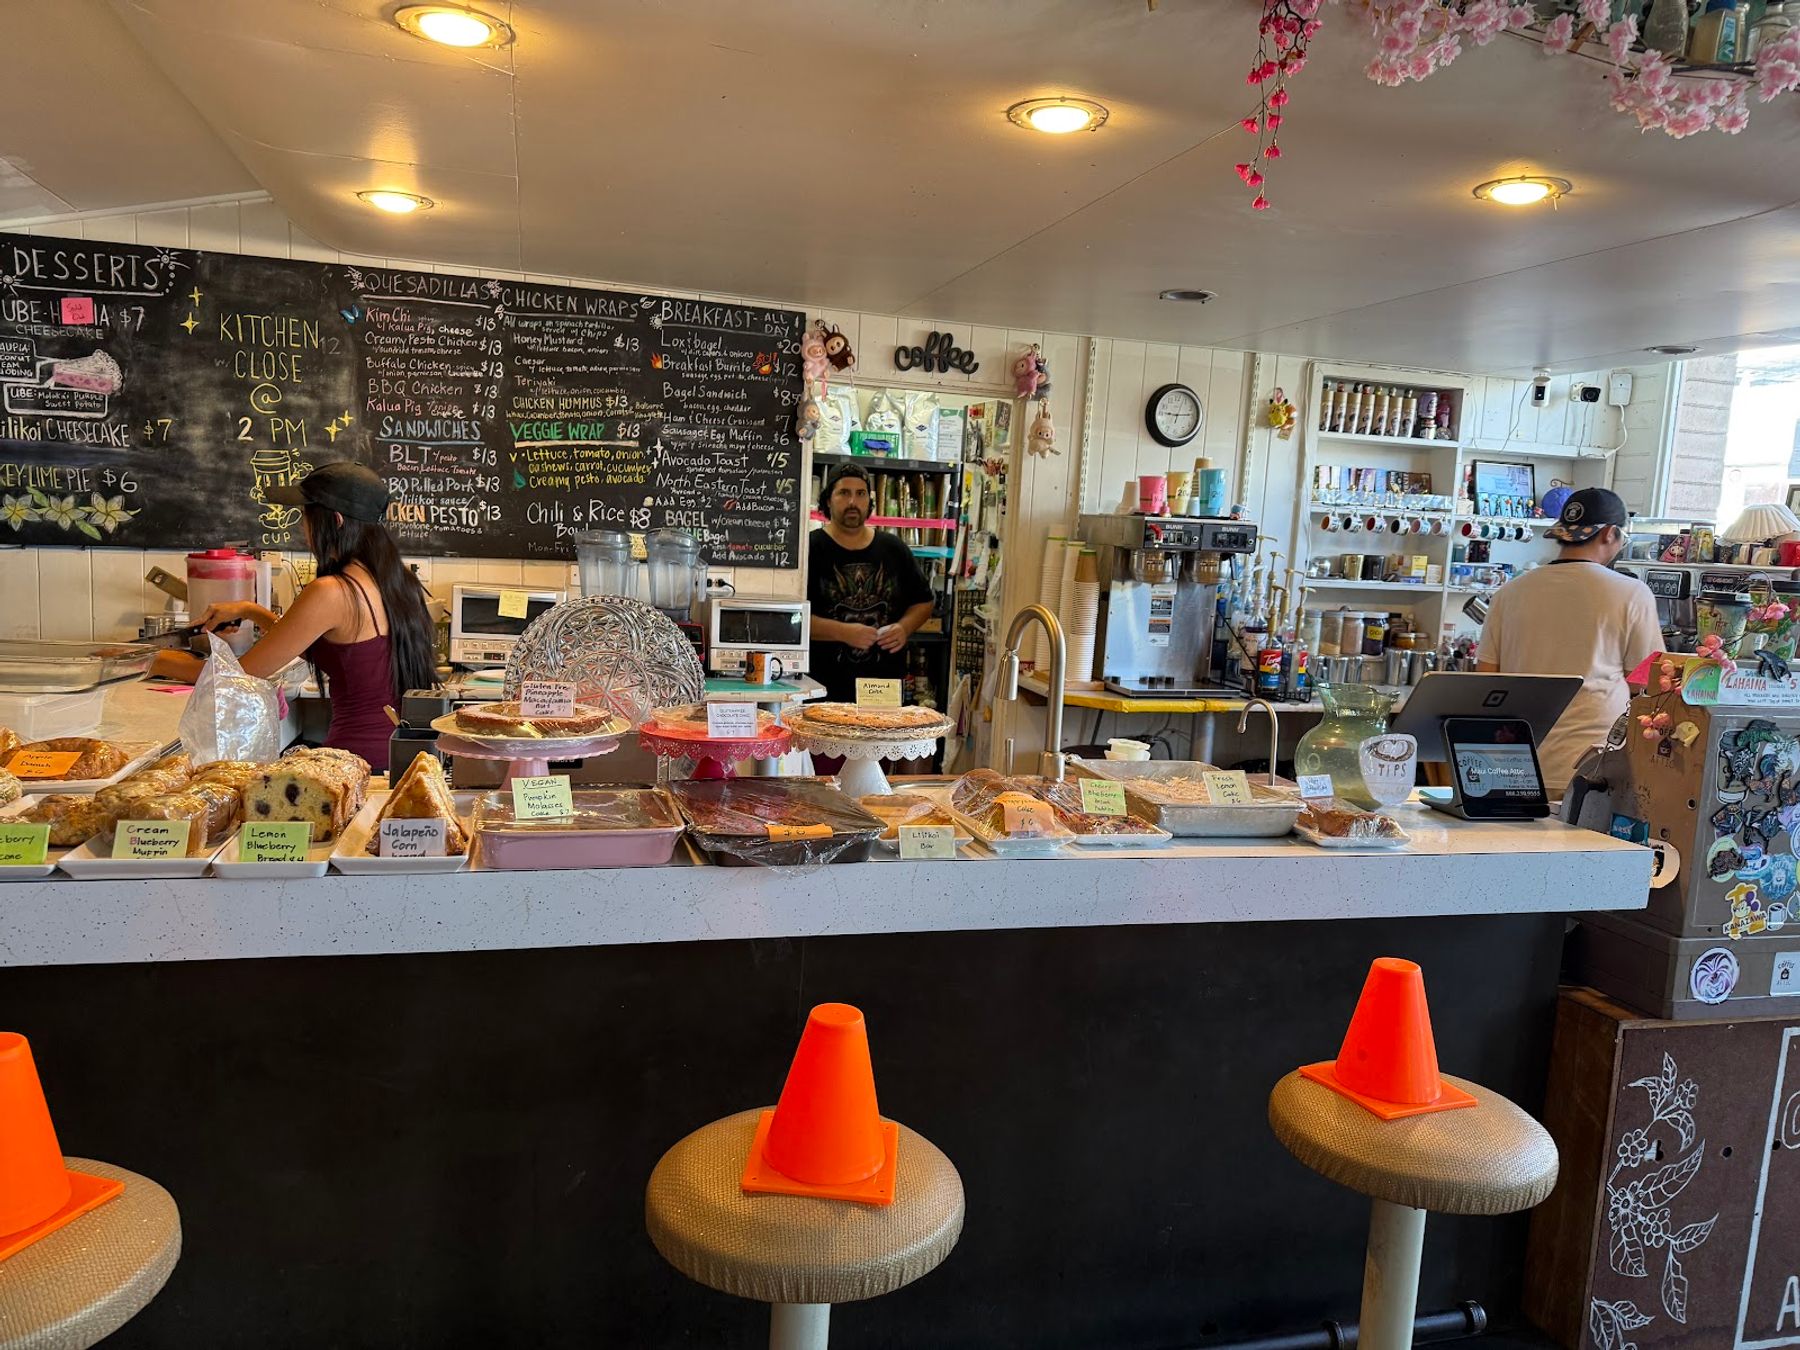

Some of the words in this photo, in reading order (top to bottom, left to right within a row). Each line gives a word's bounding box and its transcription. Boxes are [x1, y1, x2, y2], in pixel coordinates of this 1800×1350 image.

[14, 247, 160, 290] DESSERTS
[364, 273, 490, 300] QUESADILLAS
[502, 288, 578, 313] CHICKEN
[585, 297, 639, 318] WRAPS
[120, 306, 144, 332] $7
[366, 307, 390, 322] Kim
[392, 307, 411, 322] Chi
[475, 315, 496, 331] $13
[504, 316, 515, 327] All
[518, 320, 542, 330] wraps
[764, 313, 788, 324] ALL
[15, 324, 104, 339] CHEESECAKE
[220, 313, 318, 349] KITCHEN
[388, 322, 415, 332] Kalua
[438, 325, 474, 337] cheese
[581, 330, 607, 339] Chips
[764, 324, 789, 338] DAY
[365, 331, 406, 348] Creamy
[408, 335, 435, 345] Pesto
[438, 336, 477, 346] Chicken
[478, 337, 502, 355] $13
[513, 332, 542, 346] Honey
[544, 334, 583, 345] Mustard
[613, 333, 640, 352] $13
[661, 330, 684, 347] Lox
[694, 332, 722, 353] bagel
[776, 339, 801, 354] $20
[514, 355, 546, 365] Caesar
[894, 331, 979, 374] coffee
[235, 351, 302, 383] CLOSE
[366, 357, 405, 368] Buffalo
[409, 358, 452, 371] Chicken
[481, 360, 504, 378] $13
[662, 354, 713, 371] Breakfast
[715, 358, 751, 372] Burrito
[774, 358, 798, 377] $12
[368, 378, 406, 397] BBQ
[412, 381, 463, 395] Chicken
[474, 383, 498, 399] $13
[514, 375, 556, 388] Teriyaki
[250, 383, 282, 414] @
[663, 381, 696, 402] Bagel
[698, 385, 747, 398] Sandwich
[367, 397, 401, 411] Kalua
[405, 399, 422, 416] Pig
[472, 402, 496, 418] $13
[513, 396, 555, 410] CHICKEN
[559, 397, 602, 409] HUMMUS
[605, 395, 628, 409] $13
[237, 416, 254, 441] 2
[270, 418, 307, 446] PM
[379, 415, 481, 440] SANDWICHES
[509, 421, 563, 440] VEGGIE
[568, 422, 605, 440] WRAP
[617, 422, 640, 439] $13
[663, 411, 685, 422] Ham
[695, 412, 724, 424] Cheese
[775, 414, 790, 433] $7
[46, 418, 130, 447] CHEESECAKE
[143, 419, 172, 441] $7
[661, 424, 703, 437] Sausage
[710, 429, 725, 442] Egg
[729, 429, 762, 441] Muffin
[774, 432, 789, 446] $6
[390, 444, 432, 464] BLT
[472, 447, 497, 466] $13
[526, 448, 572, 461] Lettuce,
[573, 447, 614, 460] tomato,
[616, 451, 646, 459] onion,
[661, 450, 711, 466] Avocado
[712, 452, 749, 467] Toast
[767, 452, 790, 468] $15
[66, 467, 91, 492] PIE
[102, 468, 138, 493] $6
[381, 477, 408, 496] BQ
[411, 477, 443, 492] Pulled
[446, 478, 475, 493] Pork
[475, 474, 500, 492] $13
[529, 475, 570, 492] Creamy
[574, 473, 603, 489] pesto,
[656, 473, 691, 490] North
[694, 474, 738, 493] Eastern
[740, 478, 766, 495] Toast
[440, 496, 467, 505] sauce
[655, 494, 675, 506] Add
[700, 496, 712, 508] $2
[735, 501, 752, 511] Add
[386, 502, 426, 522] ICKEN
[430, 505, 478, 526] PESTO
[479, 500, 501, 520] $13
[527, 500, 563, 524] Chili
[573, 506, 583, 521] &
[589, 499, 625, 522] Rice
[629, 507, 651, 529] $8
[665, 510, 709, 527] BAGEL
[744, 516, 770, 528] Cheese
[774, 517, 791, 528] $4
[262, 533, 291, 545] CUP
[703, 529, 729, 545] Bagel
[768, 529, 785, 544] $9
[712, 551, 727, 560] Add
[728, 551, 765, 560] Avocado
[770, 552, 790, 567] $12
[525, 689, 563, 697] Pineapple
[1725, 677, 1767, 691] LAHAINA
[1378, 762, 1407, 778] TIPS
[1487, 767, 1509, 775] Coffee
[522, 779, 557, 788] VEGAN
[523, 791, 557, 802] Pumpkin
[127, 824, 169, 834] Cream
[251, 828, 286, 838] Lemon
[382, 823, 439, 841] Jalapeño
[912, 831, 940, 839] Lilikoi
[130, 837, 180, 848] Blueberry
[247, 841, 296, 853] Blueberry
[391, 839, 418, 850] Corn
[257, 854, 286, 862] Bread
[1724, 911, 1768, 933] KANAZAWA
